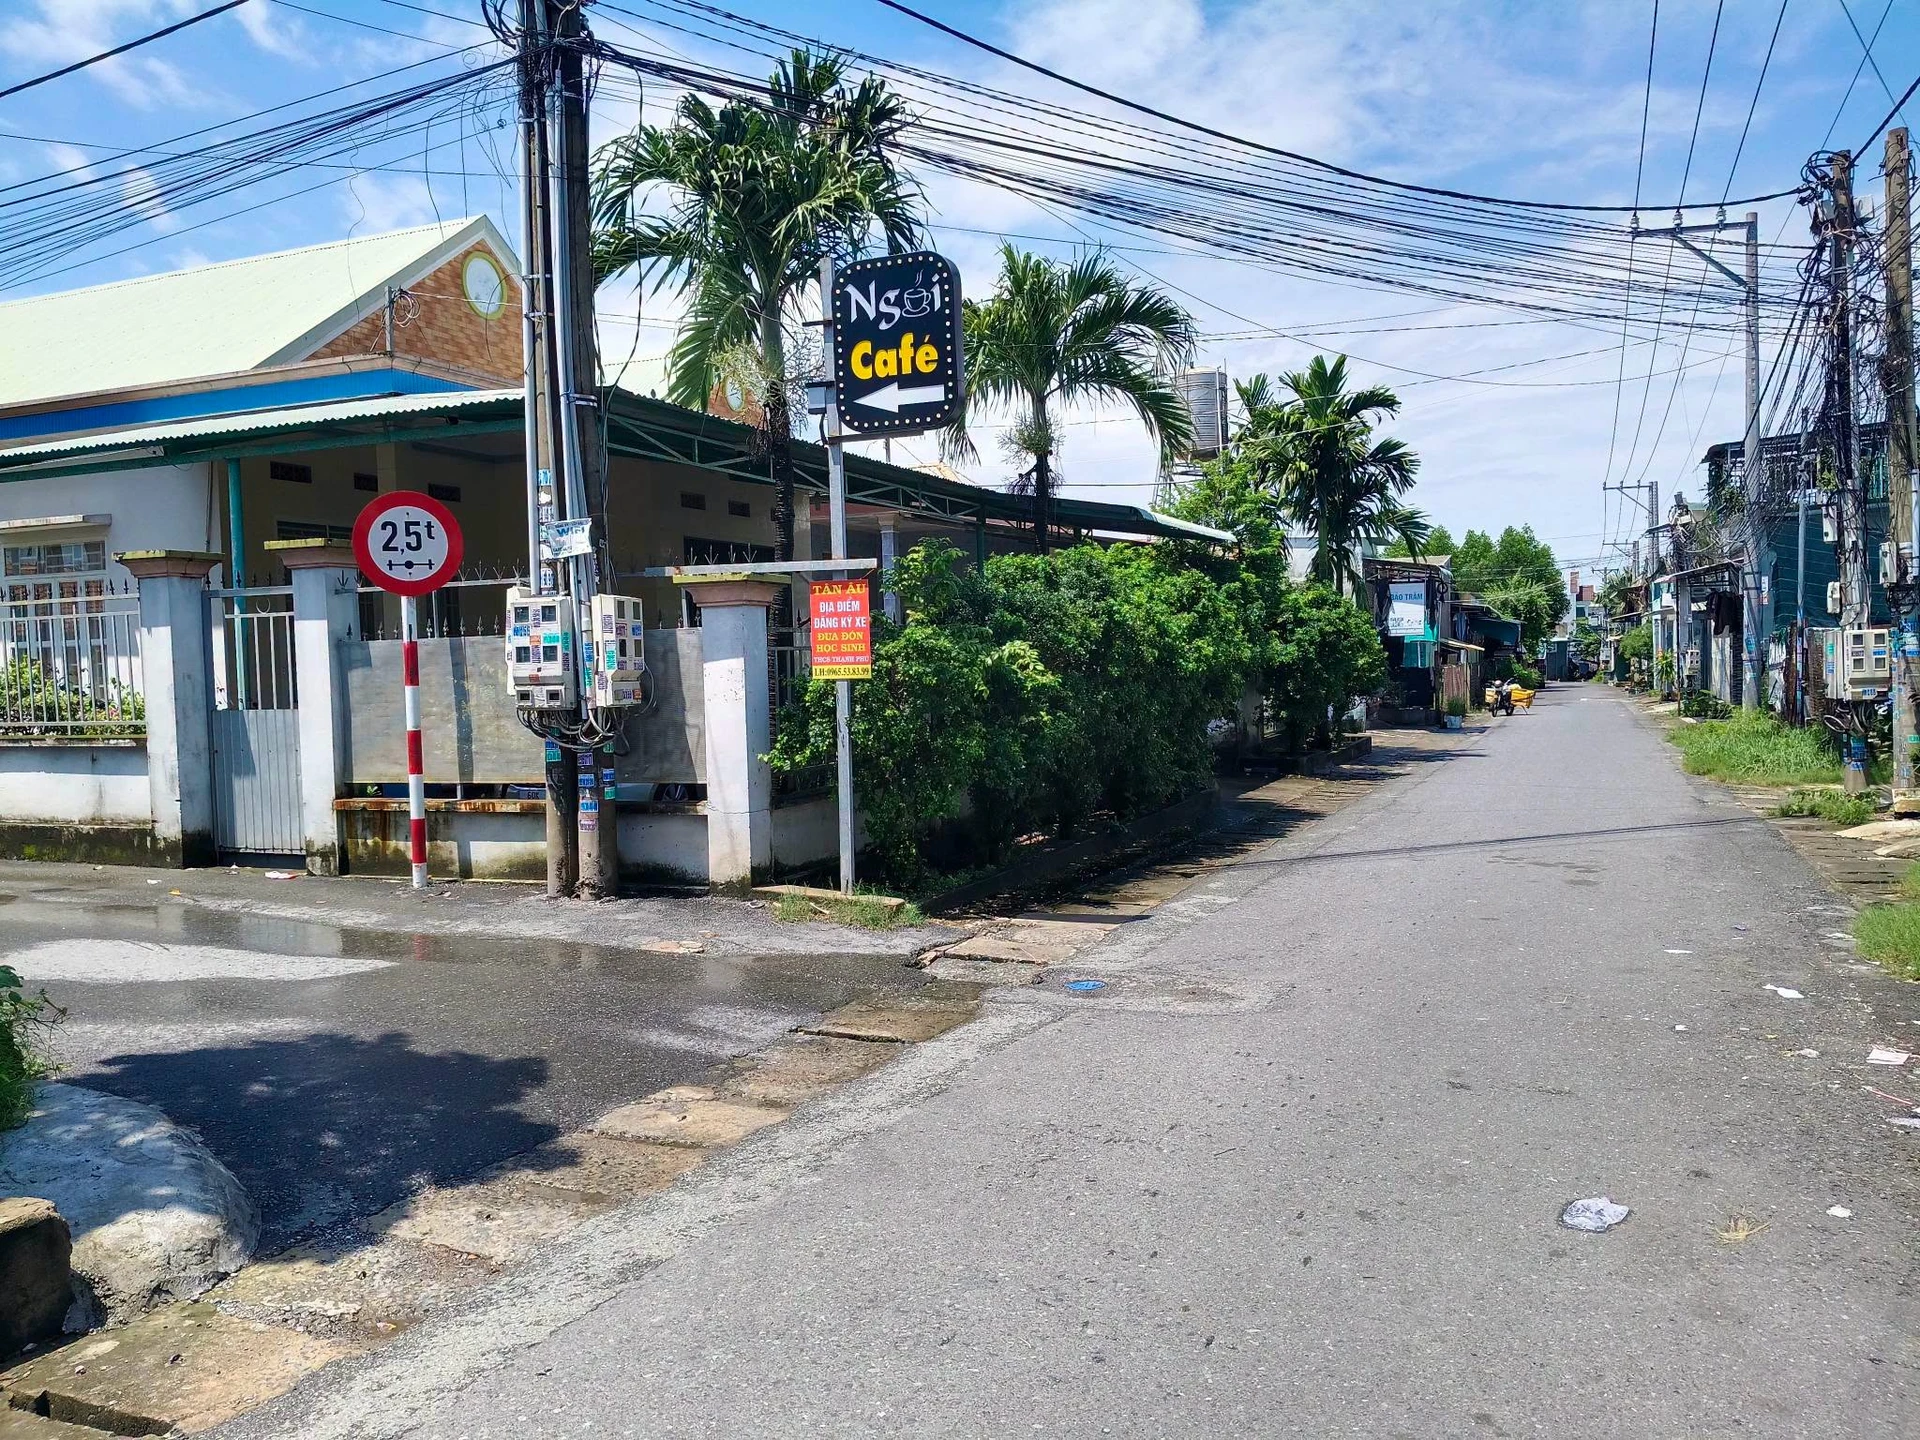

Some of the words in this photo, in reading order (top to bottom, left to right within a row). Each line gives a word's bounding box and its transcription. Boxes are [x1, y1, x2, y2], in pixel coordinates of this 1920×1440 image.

[850, 332, 939, 380] Café
[812, 583, 843, 595] TÂN
[837, 597, 860, 612] ĐIỂM
[855, 616, 867, 628] XE
[841, 630, 864, 641] ĐÓN
[816, 644, 838, 653] HỌC
[841, 643, 866, 652] SINH
